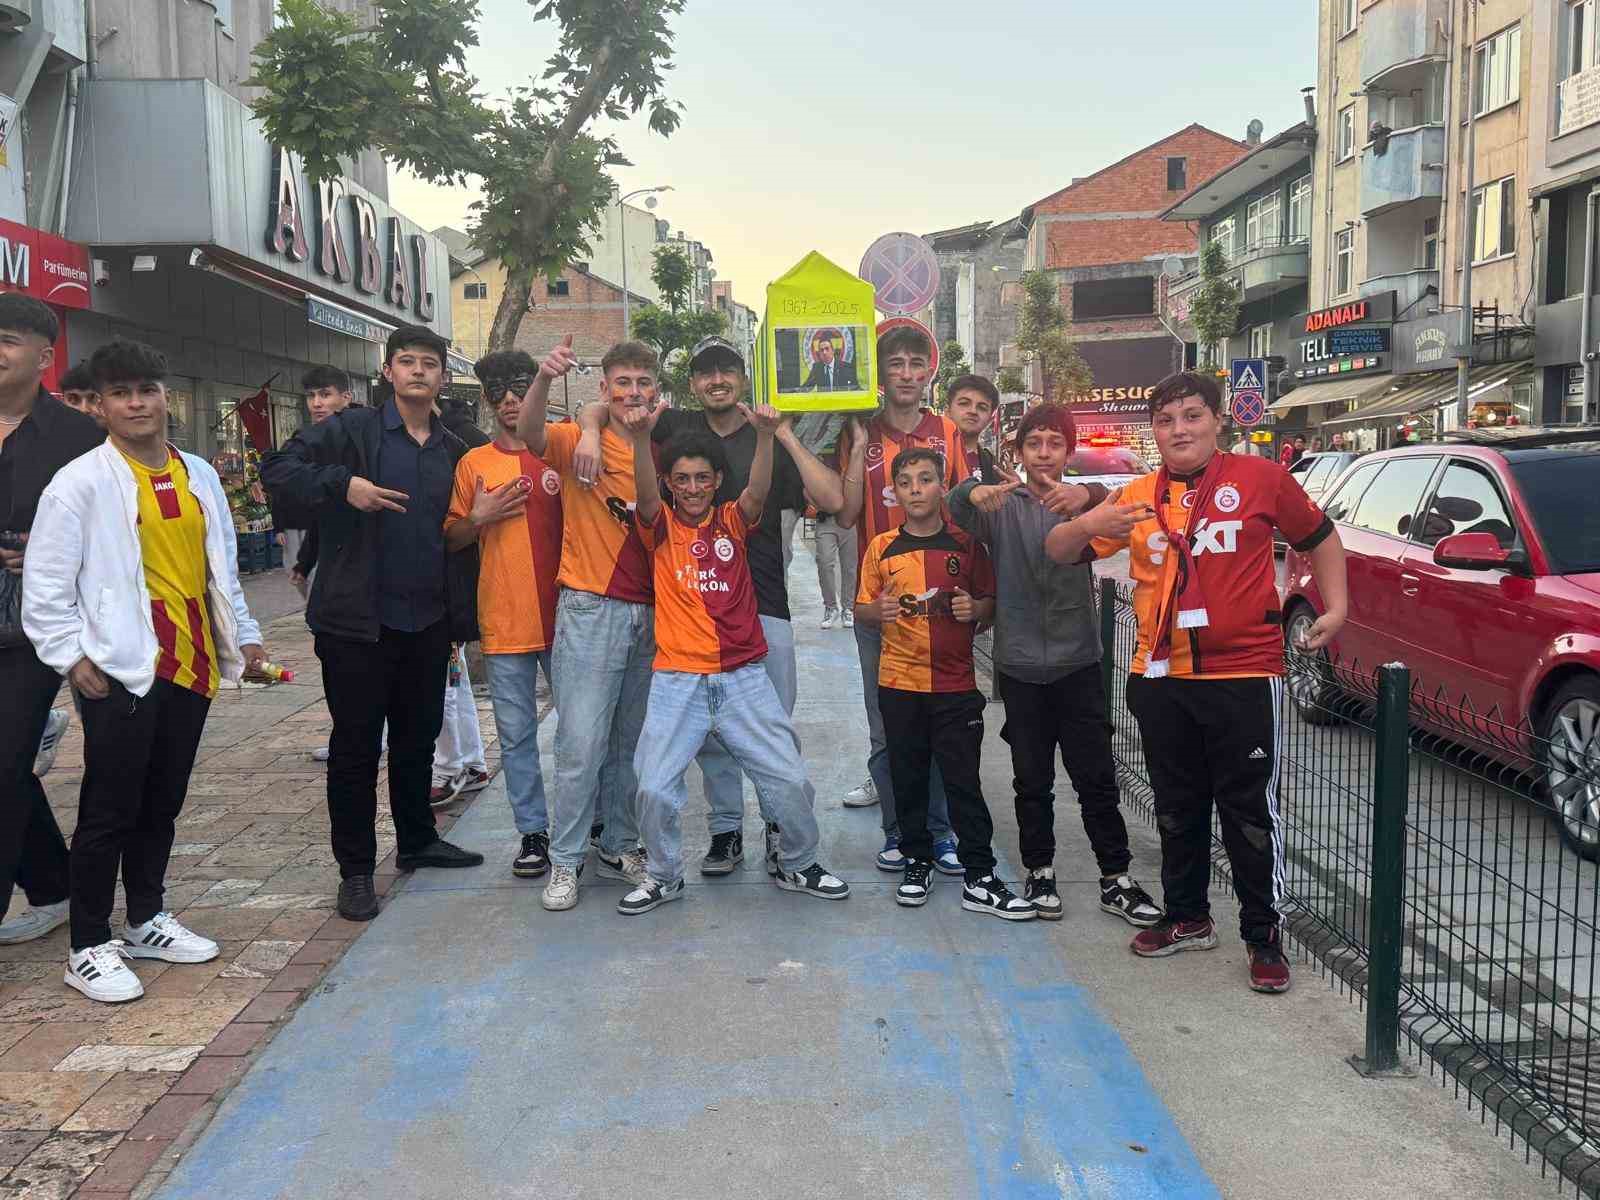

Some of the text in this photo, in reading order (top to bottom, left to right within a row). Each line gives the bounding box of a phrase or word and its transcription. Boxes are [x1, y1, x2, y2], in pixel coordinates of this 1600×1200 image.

[265, 147, 434, 322] AKBAL
[1305, 302, 1366, 332] ADANALI
[154, 482, 175, 491] JAKO
[1147, 518, 1243, 565] SXT
